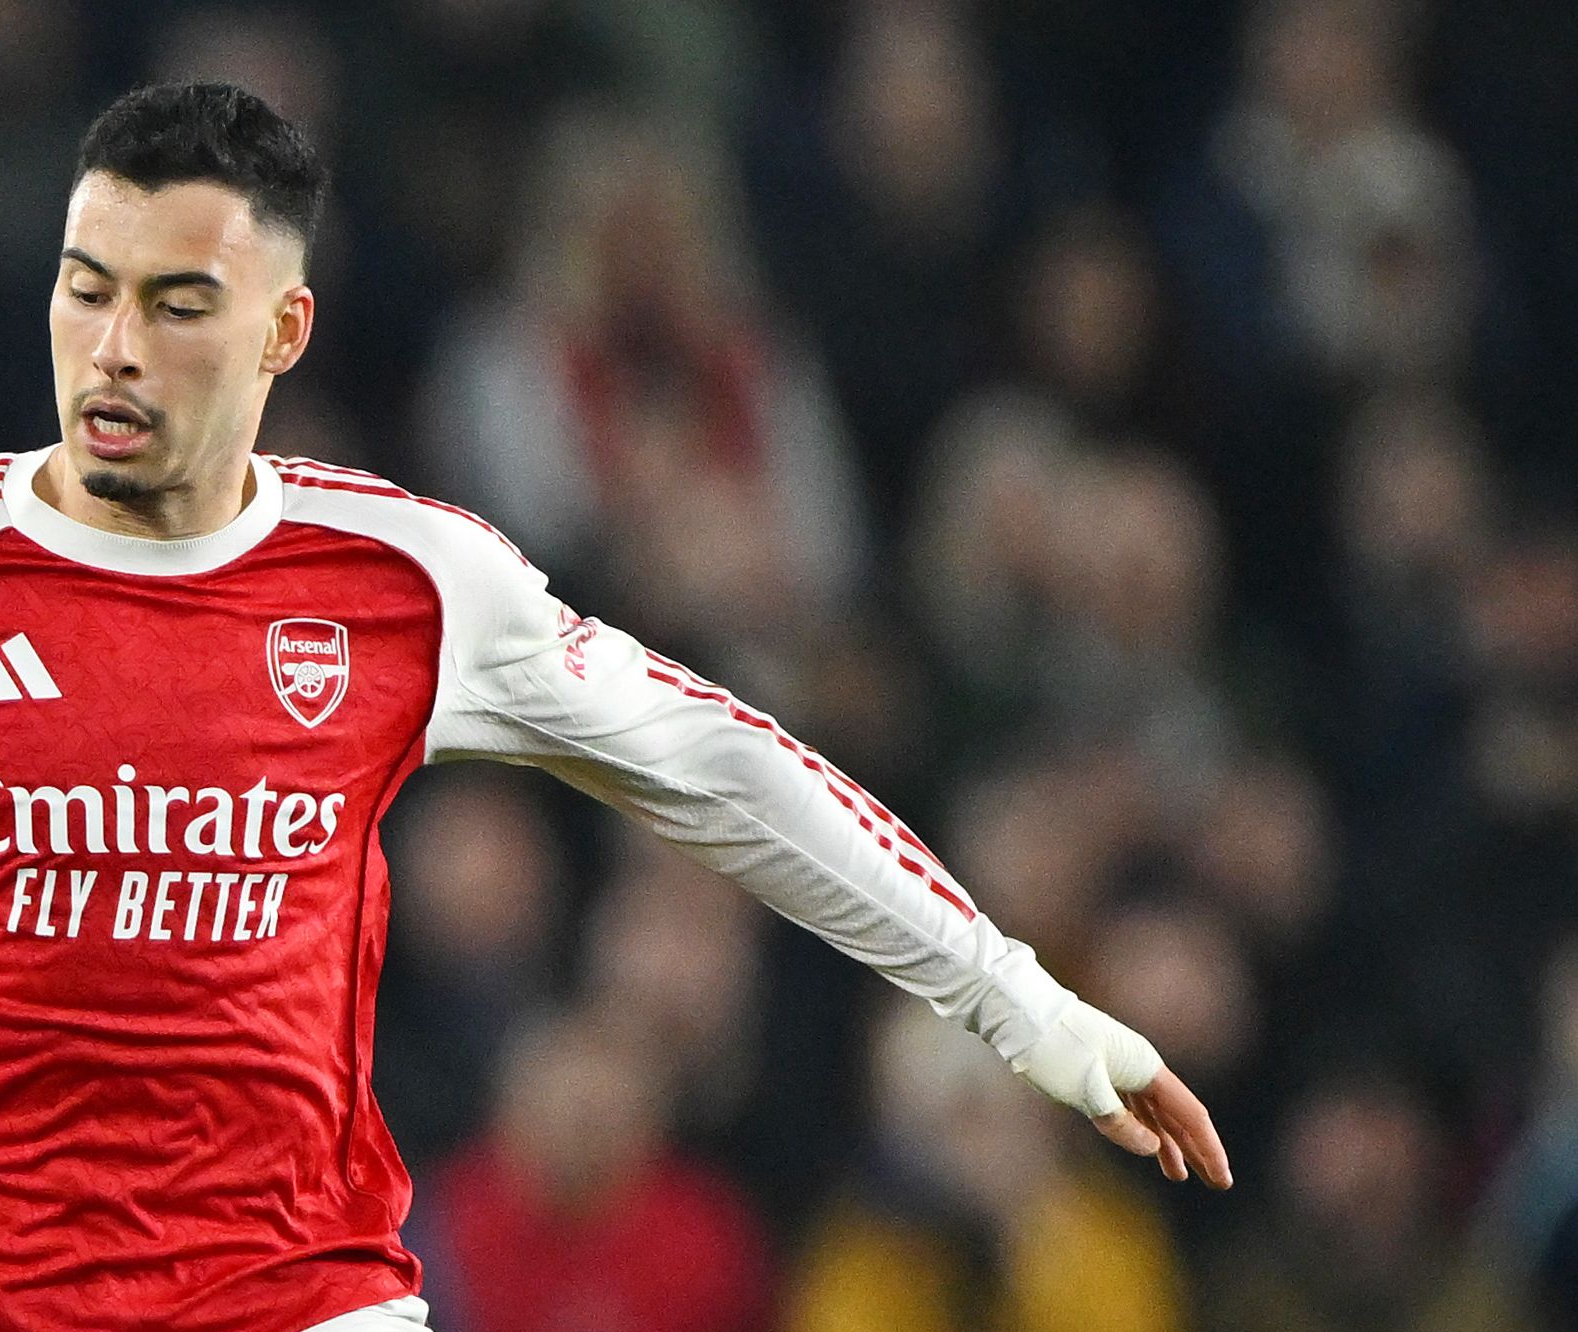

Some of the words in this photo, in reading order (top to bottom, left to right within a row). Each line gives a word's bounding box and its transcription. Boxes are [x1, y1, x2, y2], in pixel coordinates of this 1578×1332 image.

[279, 636, 337, 655] Arsenal
[7, 868, 99, 938] FLY
[112, 871, 289, 942] BETTER
